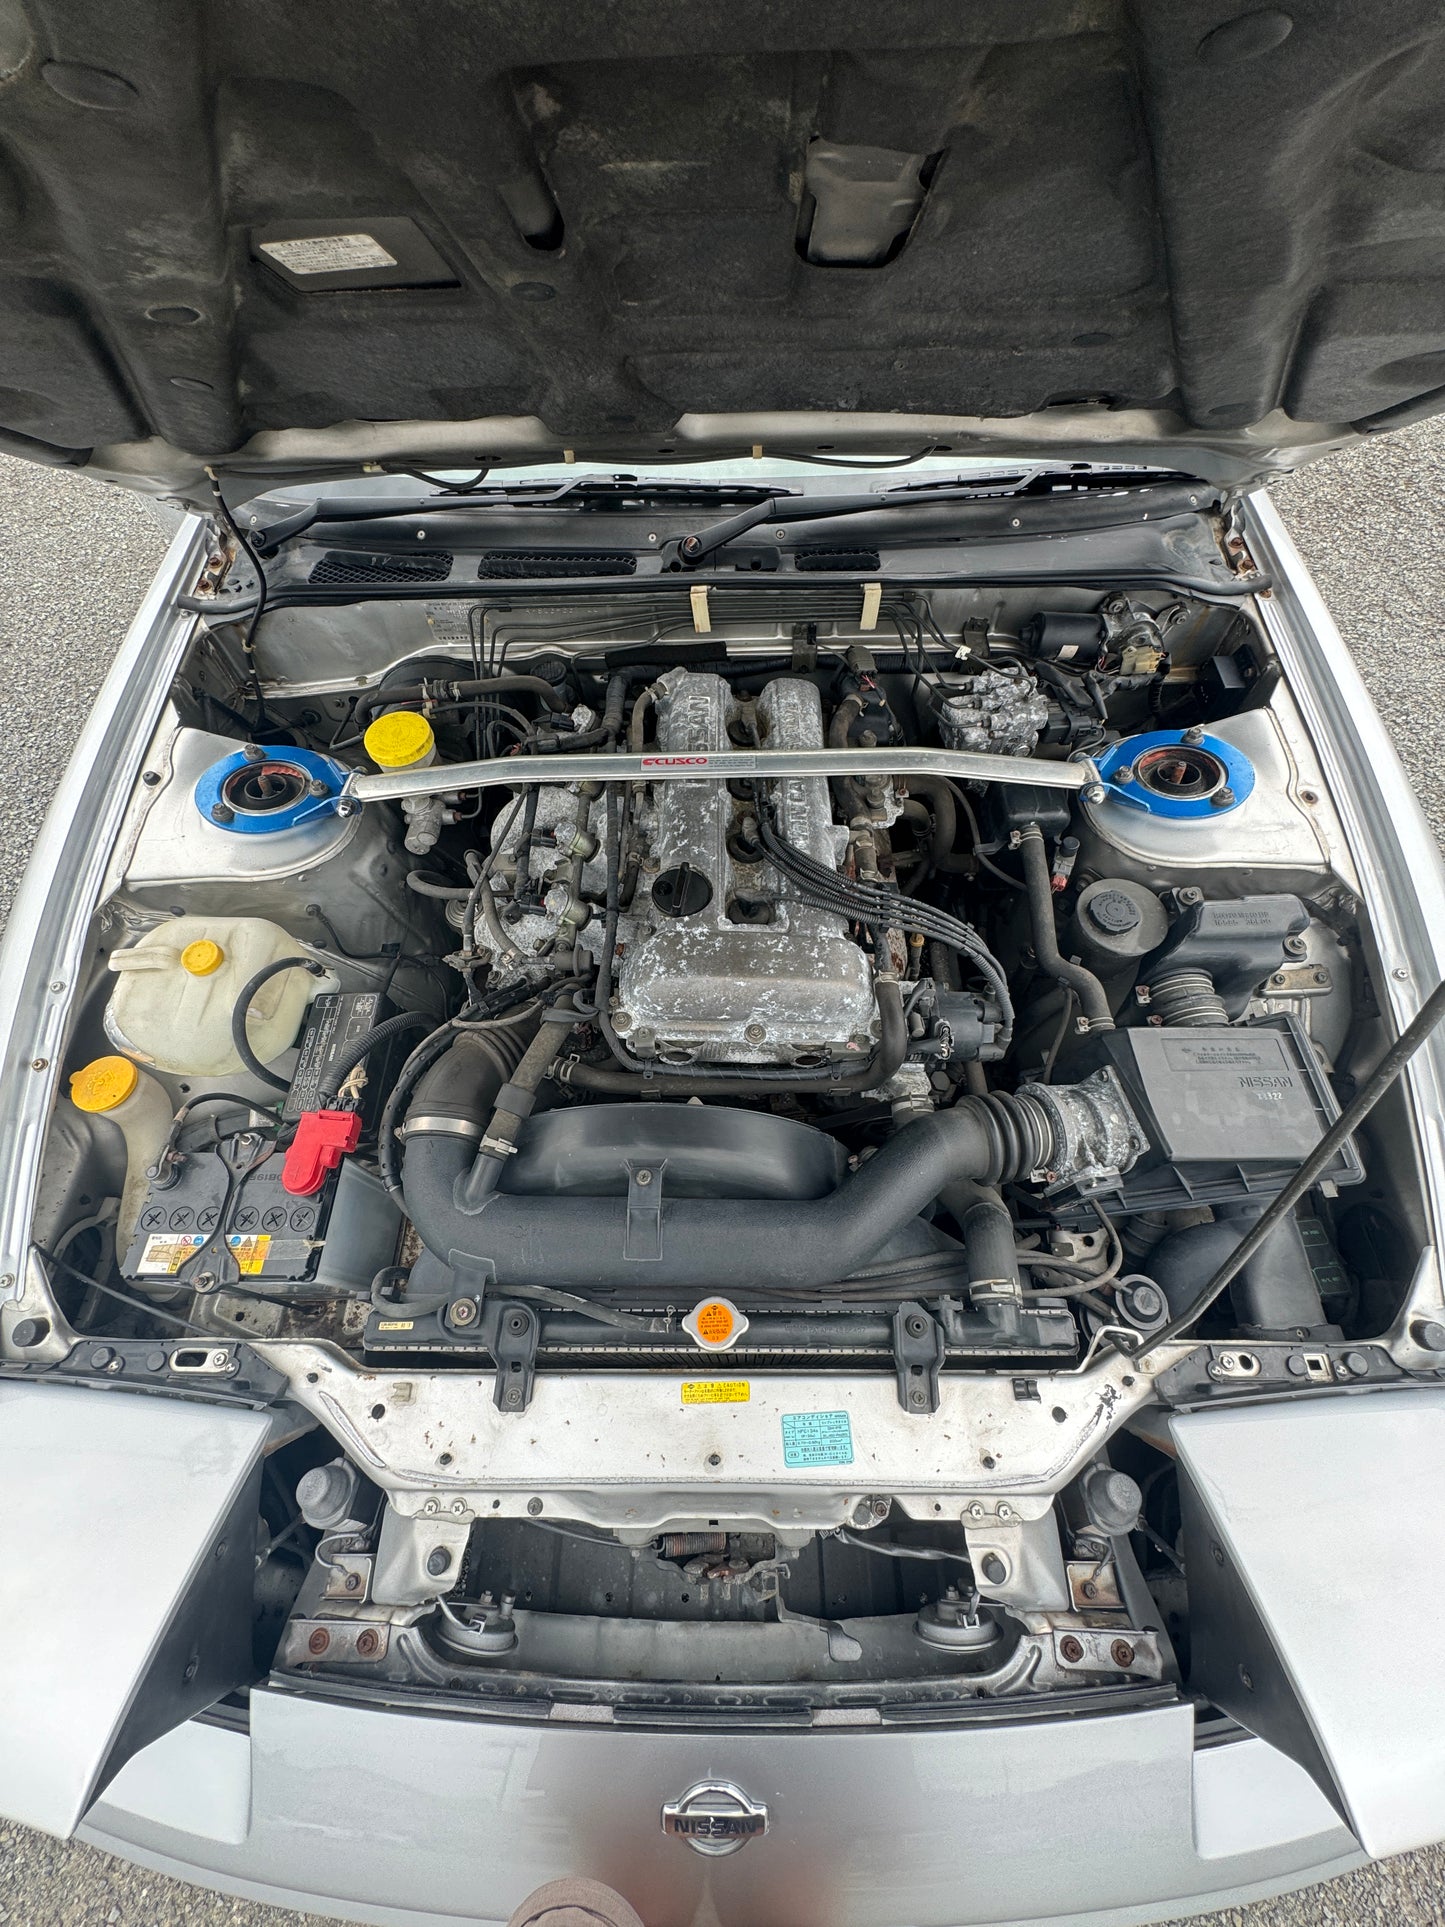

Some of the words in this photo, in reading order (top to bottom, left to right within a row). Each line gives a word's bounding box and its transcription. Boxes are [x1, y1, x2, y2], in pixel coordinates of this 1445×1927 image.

[655, 757, 708, 765] CUSCO
[1239, 1076, 1293, 1088] NISSAN
[674, 1818, 757, 1836] NISSAN
